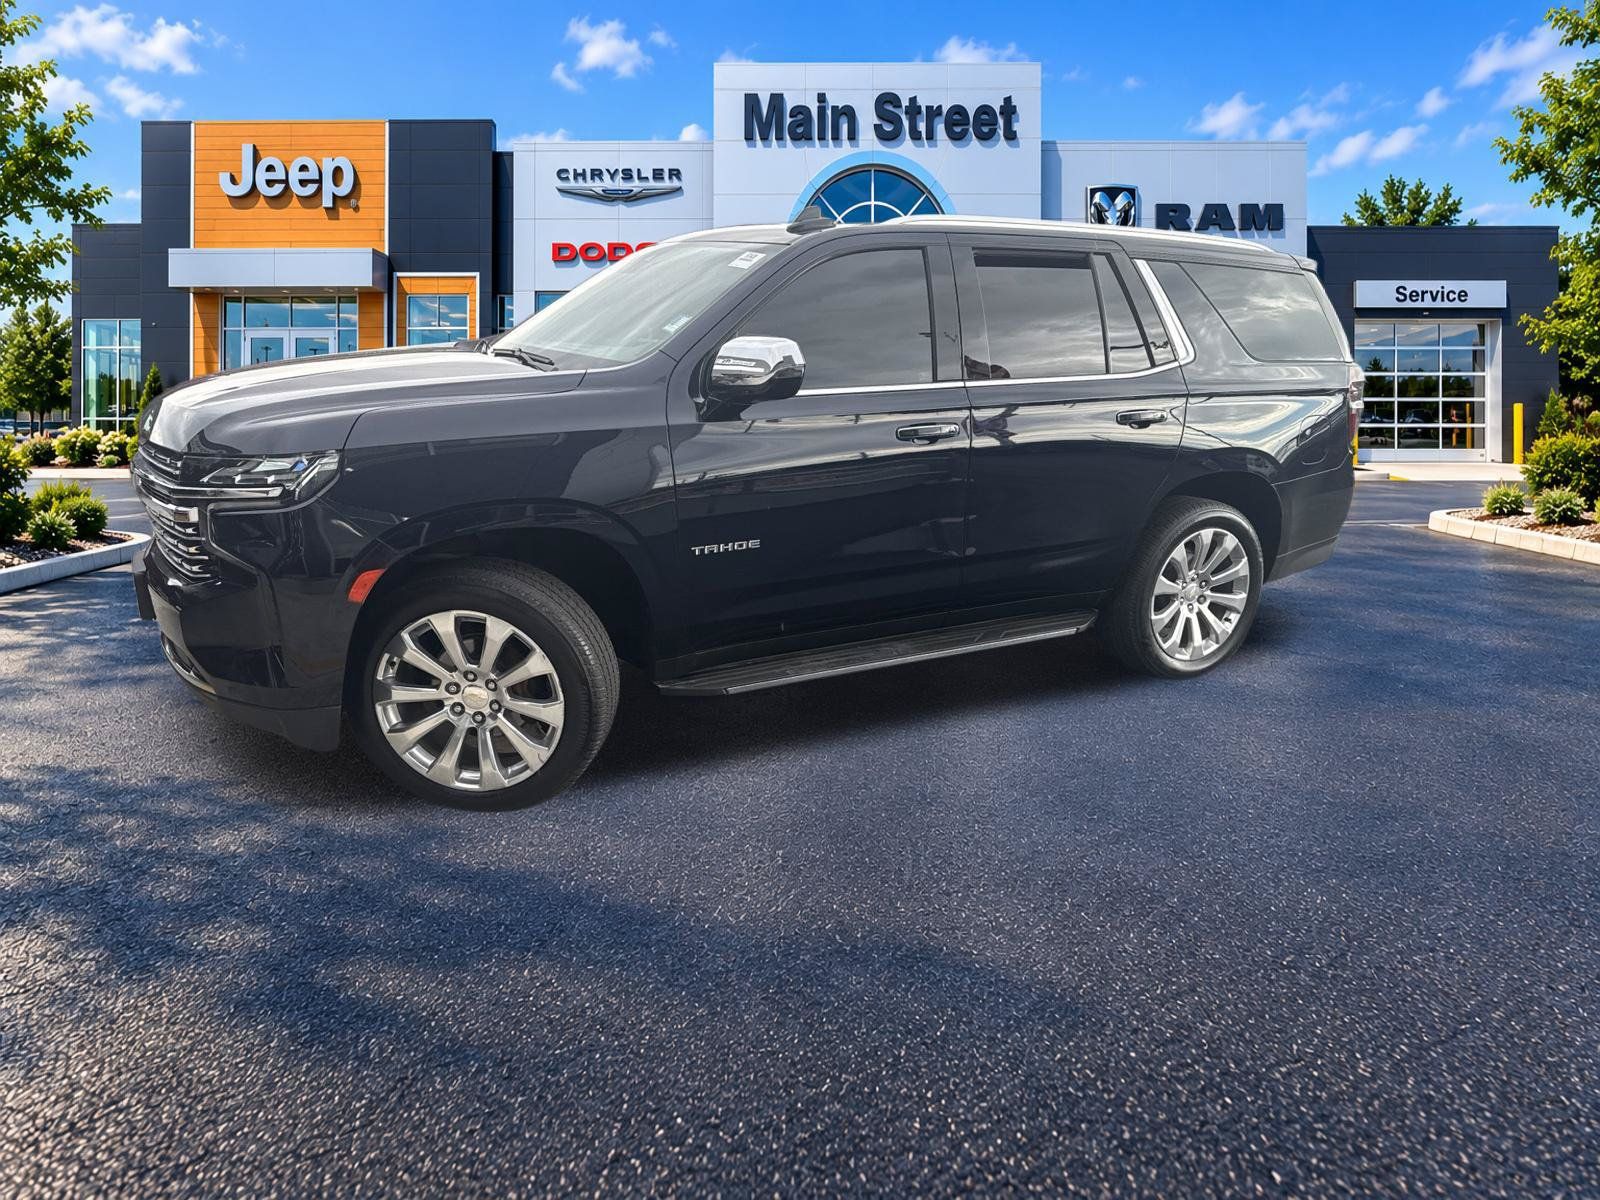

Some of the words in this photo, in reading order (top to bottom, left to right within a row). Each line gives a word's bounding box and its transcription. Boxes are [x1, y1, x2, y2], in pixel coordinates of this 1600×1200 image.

[744, 93, 856, 141] Main
[873, 92, 1017, 141] Street
[219, 144, 354, 208] Jeep
[556, 168, 682, 182] CHRYSLER
[1155, 203, 1284, 231] RAM
[1395, 285, 1469, 303] Service
[691, 539, 761, 555] TAHOE
